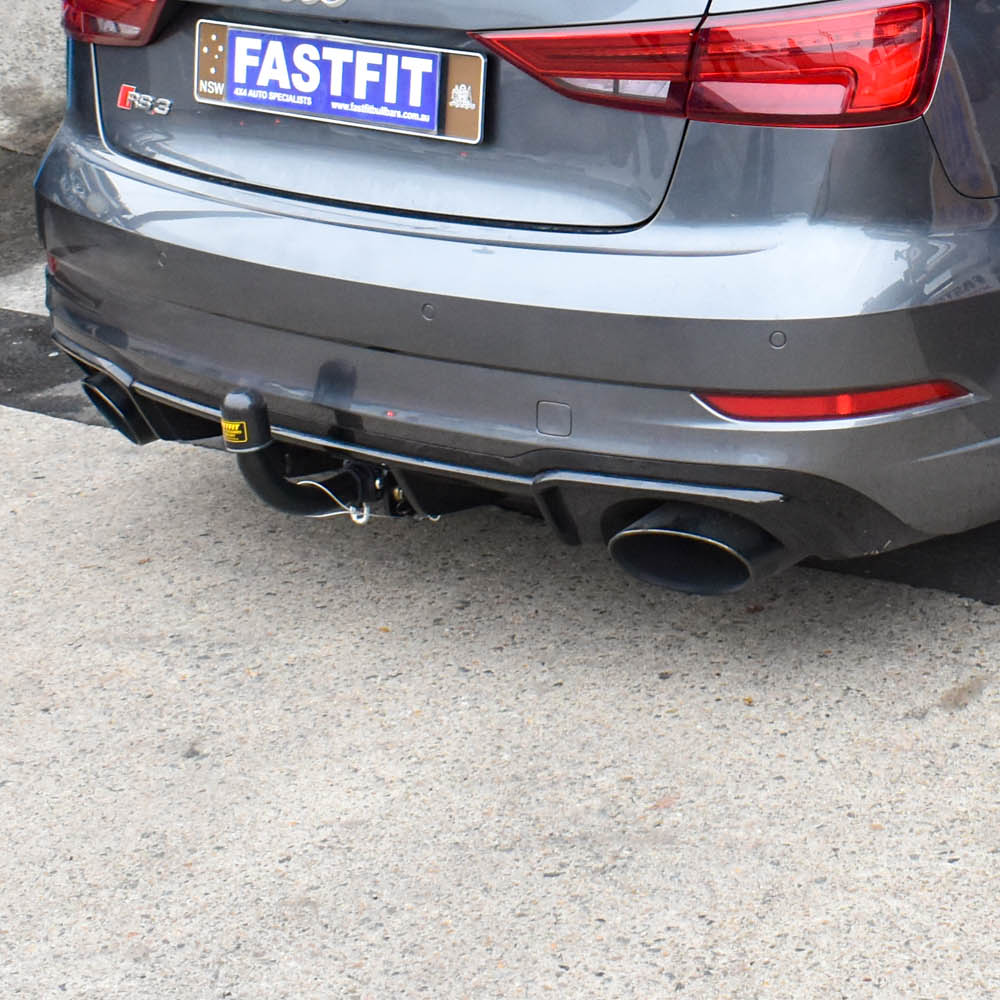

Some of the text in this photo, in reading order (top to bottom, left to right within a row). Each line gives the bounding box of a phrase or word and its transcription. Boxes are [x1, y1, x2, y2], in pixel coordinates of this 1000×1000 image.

[233, 36, 433, 108] FASTFIT
[199, 79, 225, 97] NSW
[247, 88, 268, 100] AUTO
[268, 91, 313, 106] SPECIALISTS
[122, 86, 172, 115] RS3
